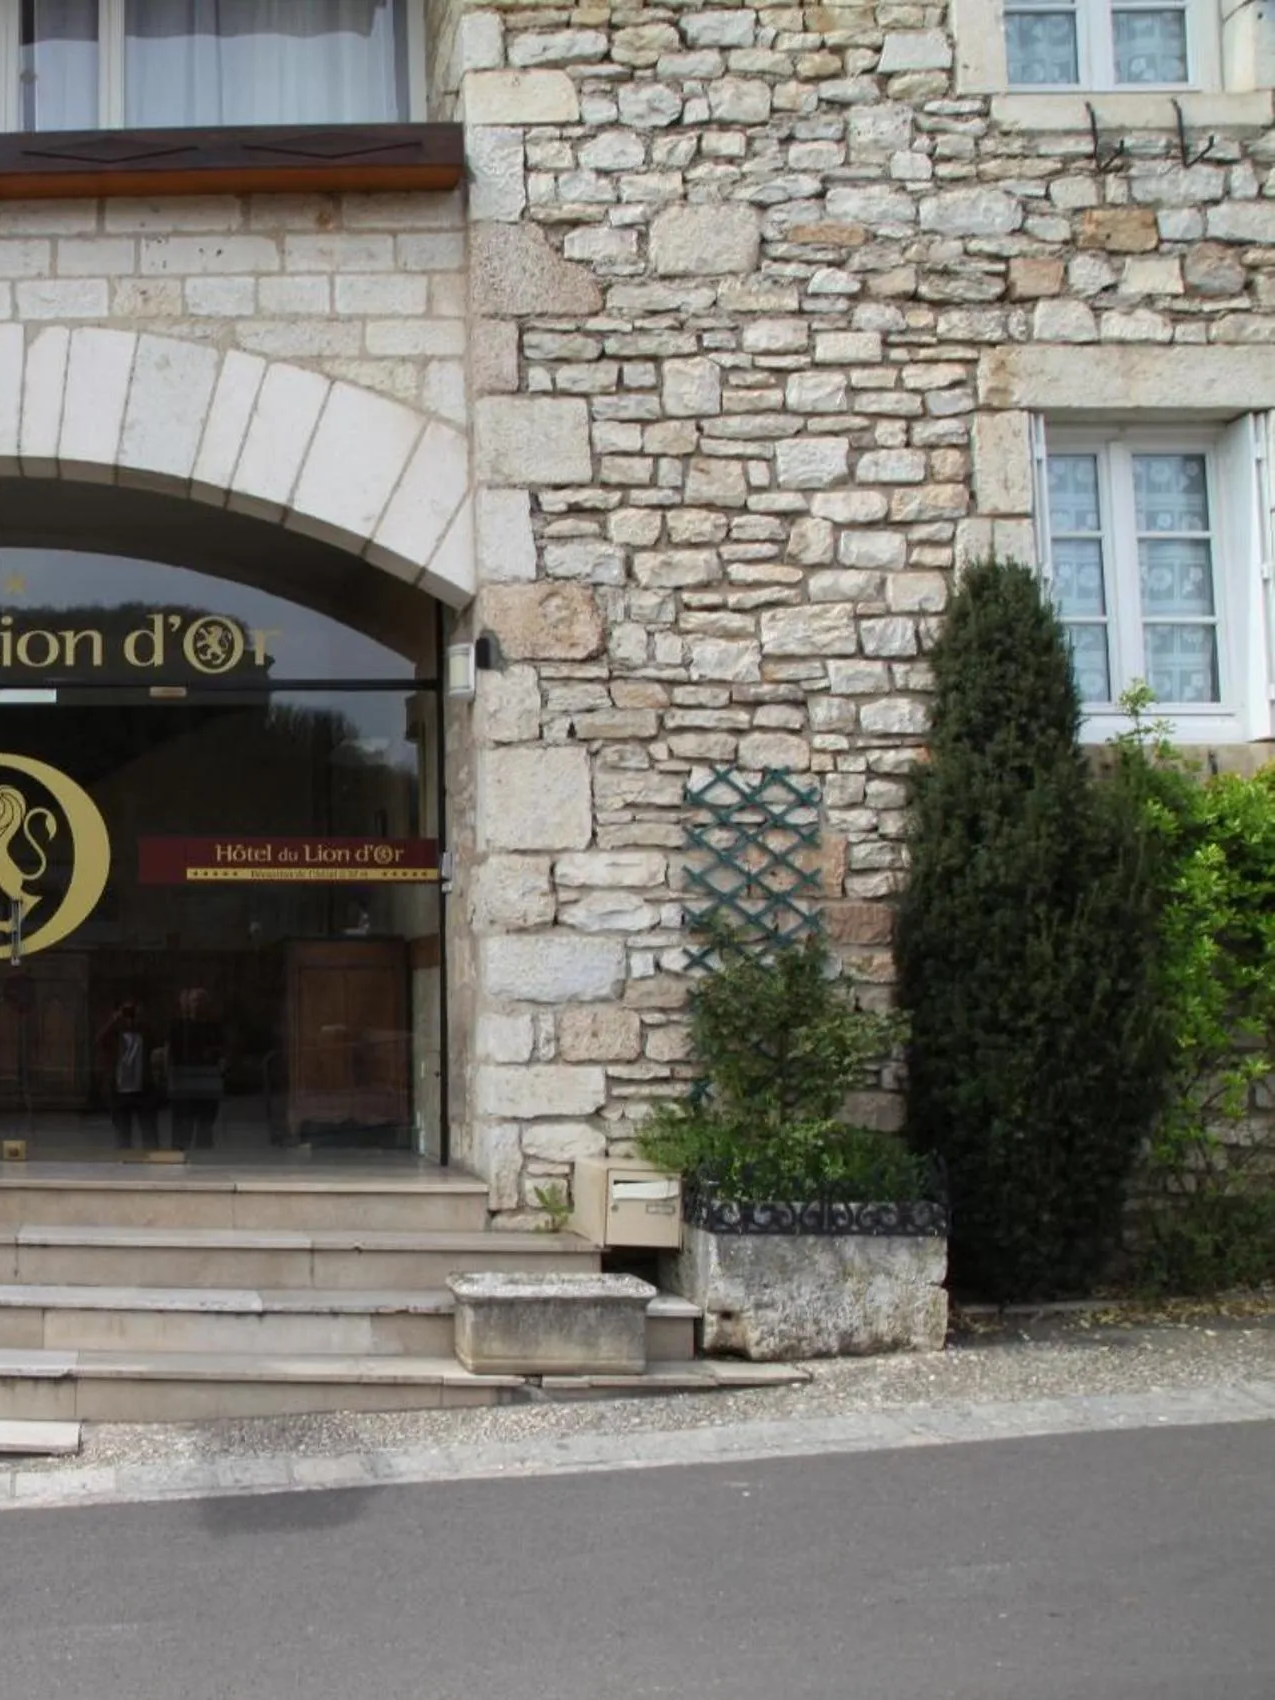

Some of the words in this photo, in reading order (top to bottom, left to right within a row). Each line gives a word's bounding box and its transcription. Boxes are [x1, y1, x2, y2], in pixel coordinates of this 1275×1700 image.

[216, 843, 272, 863] Hôtel
[278, 846, 299, 863] du
[305, 843, 351, 863] Lion
